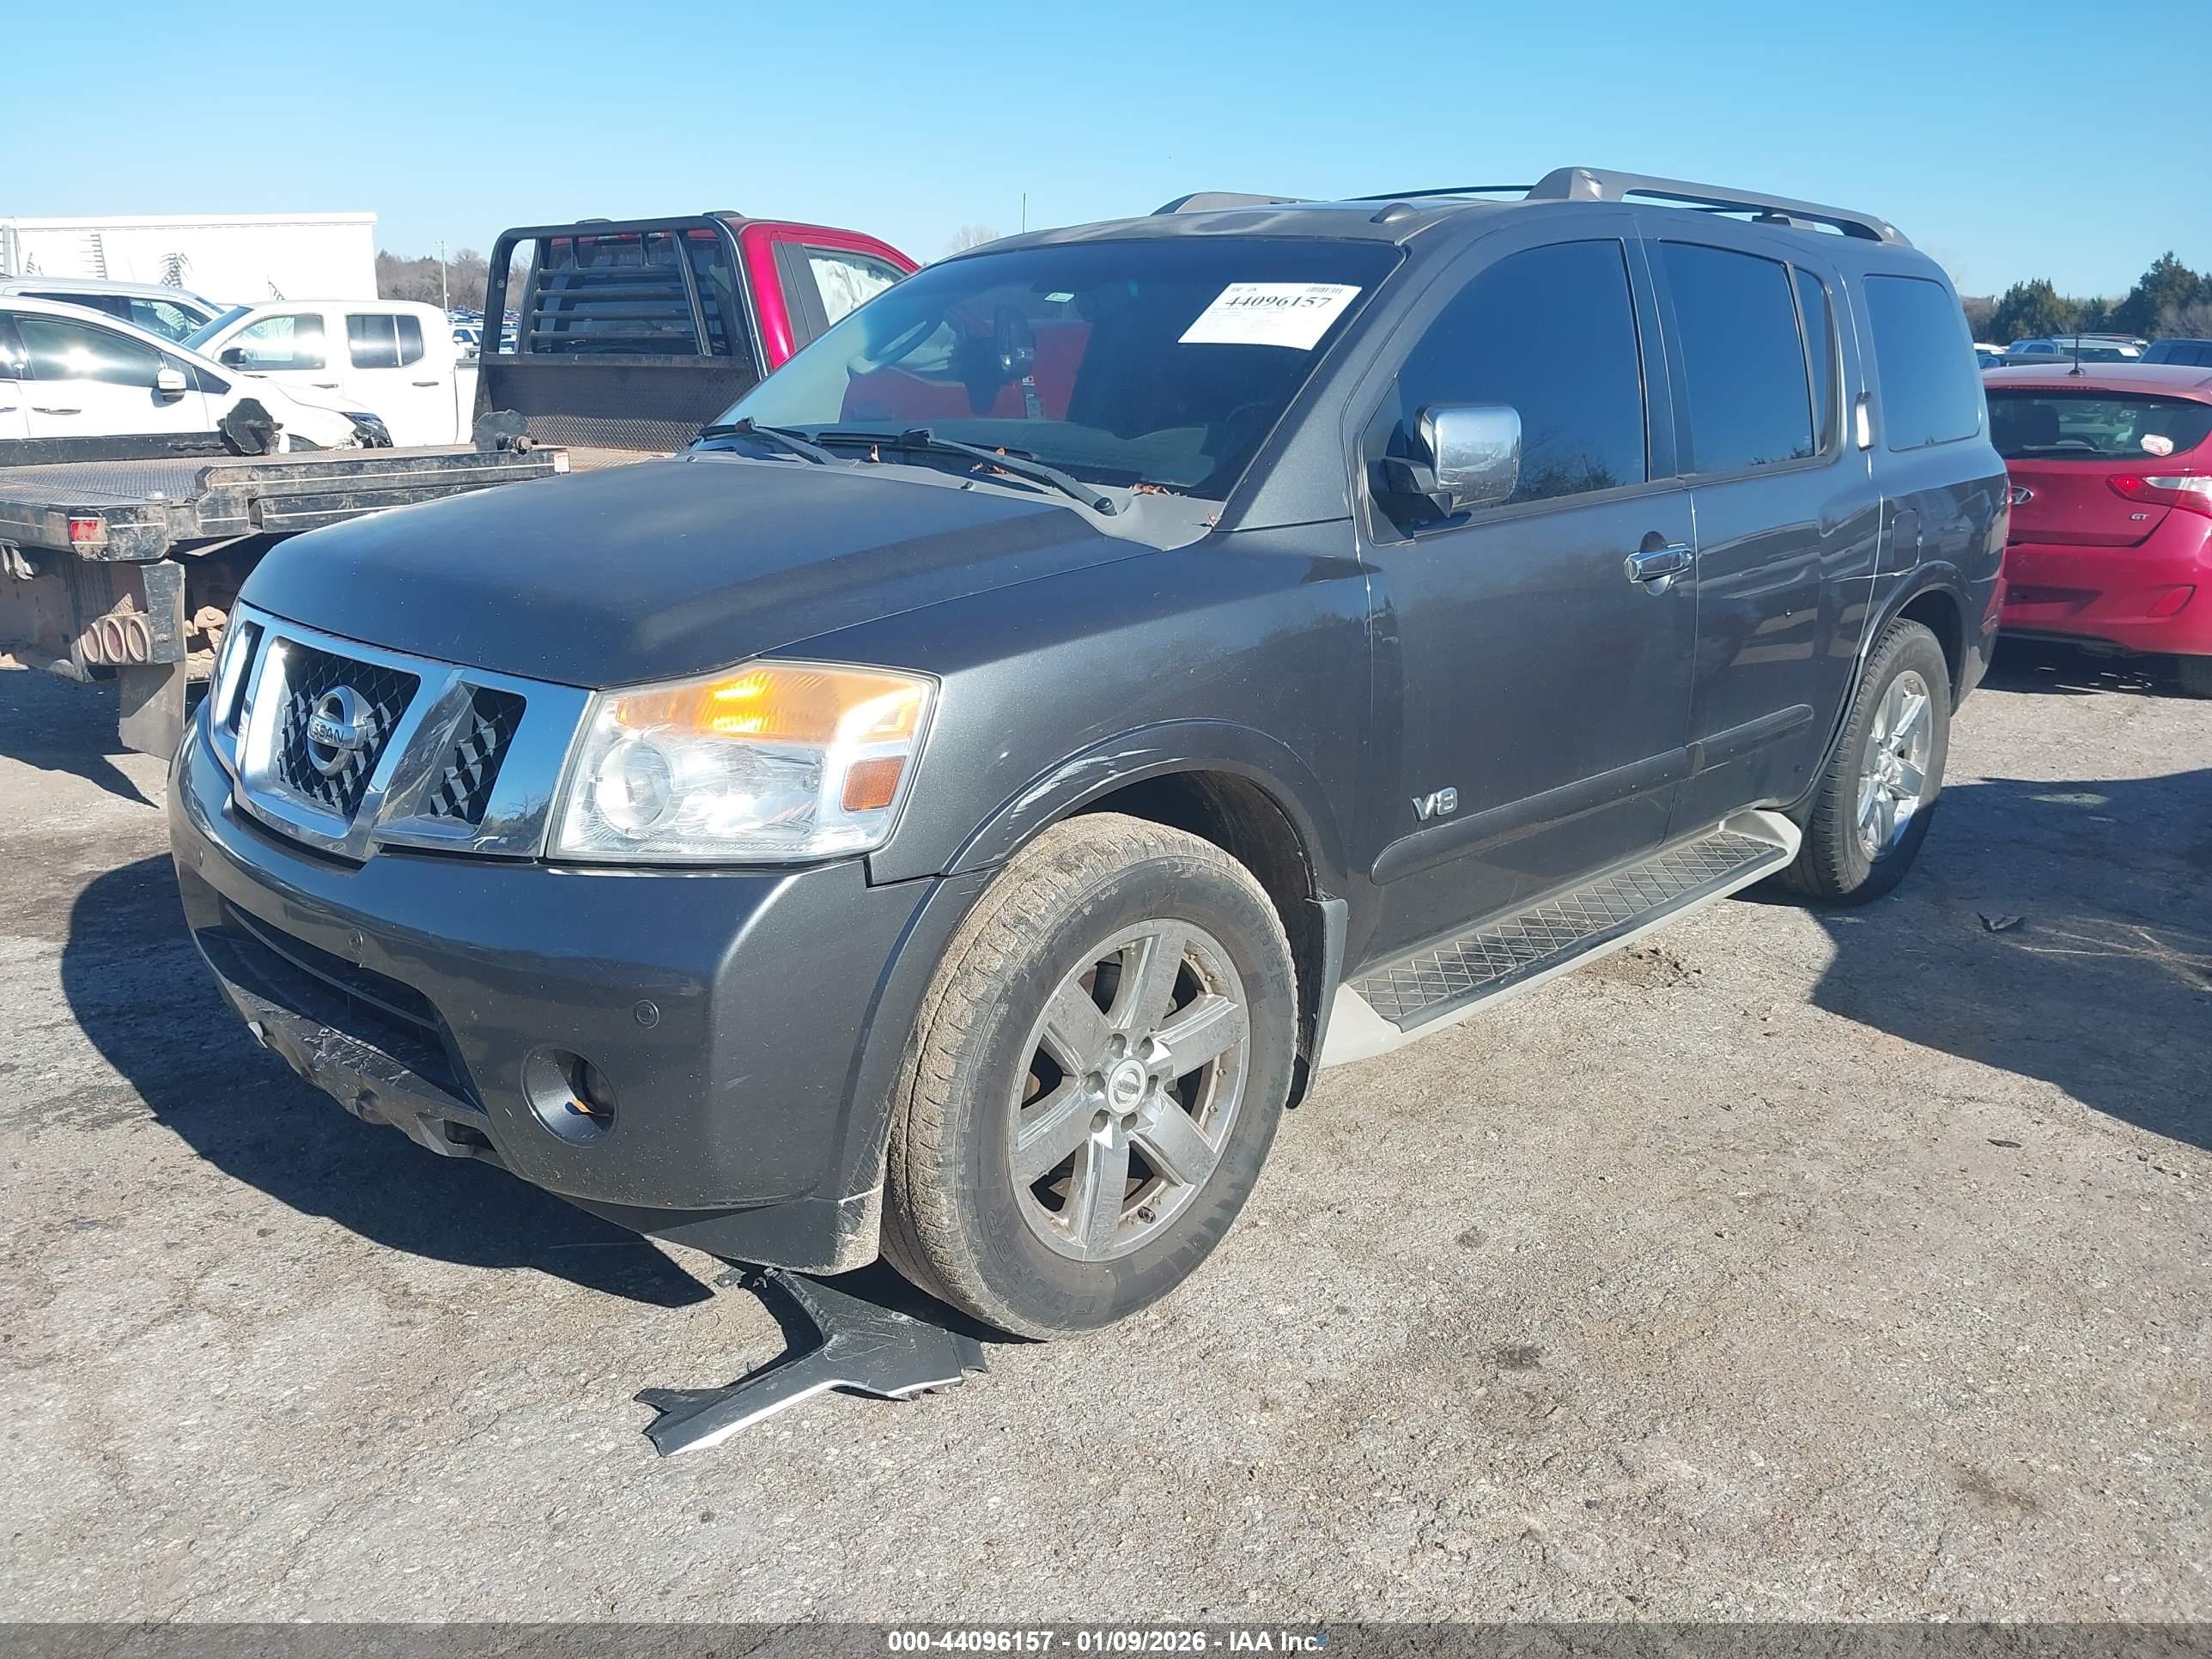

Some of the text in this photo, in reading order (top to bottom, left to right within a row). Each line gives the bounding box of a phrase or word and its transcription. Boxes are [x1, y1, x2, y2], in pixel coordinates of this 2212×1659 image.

[1224, 295, 1334, 309] 44096157
[2130, 513, 2151, 521] GT
[310, 715, 344, 744] SSAN
[1411, 787, 1458, 820] V8
